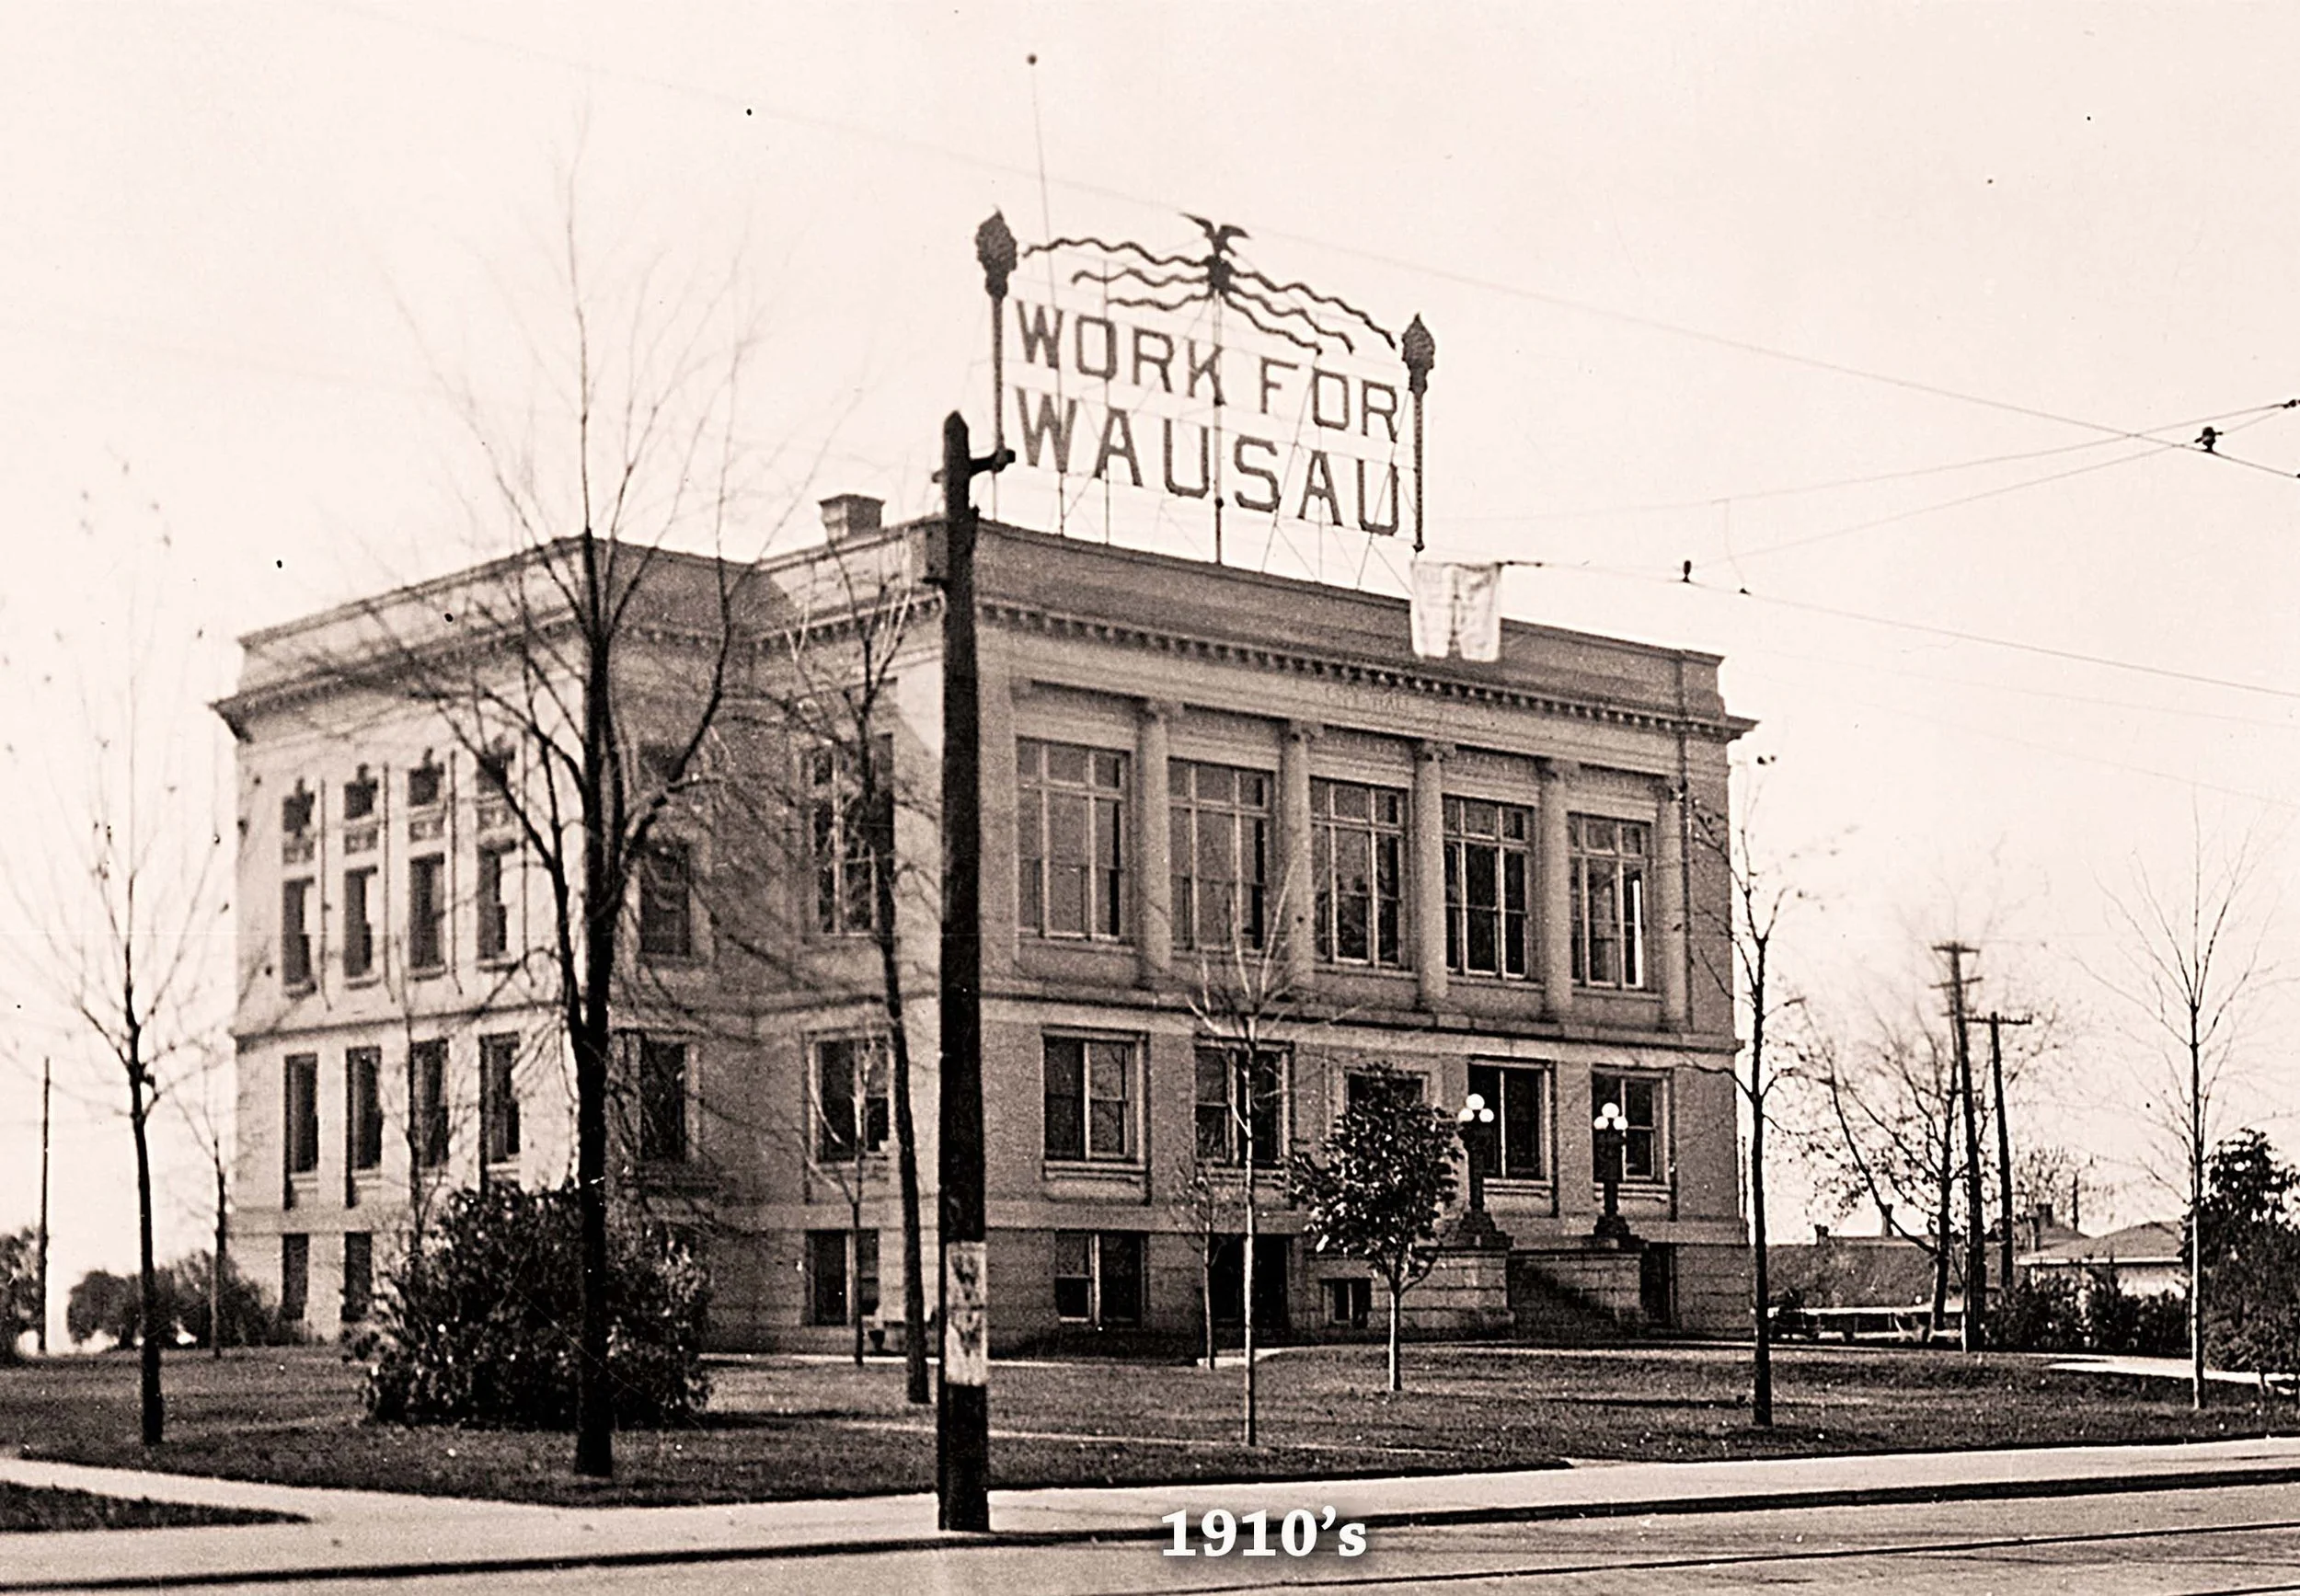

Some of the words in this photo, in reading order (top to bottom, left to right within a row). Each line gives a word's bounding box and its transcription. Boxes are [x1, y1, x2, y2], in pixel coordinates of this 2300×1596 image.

[1017, 300, 1225, 405] WORK
[1259, 356, 1397, 443] FOR
[1017, 387, 1399, 536] WAUSAU
